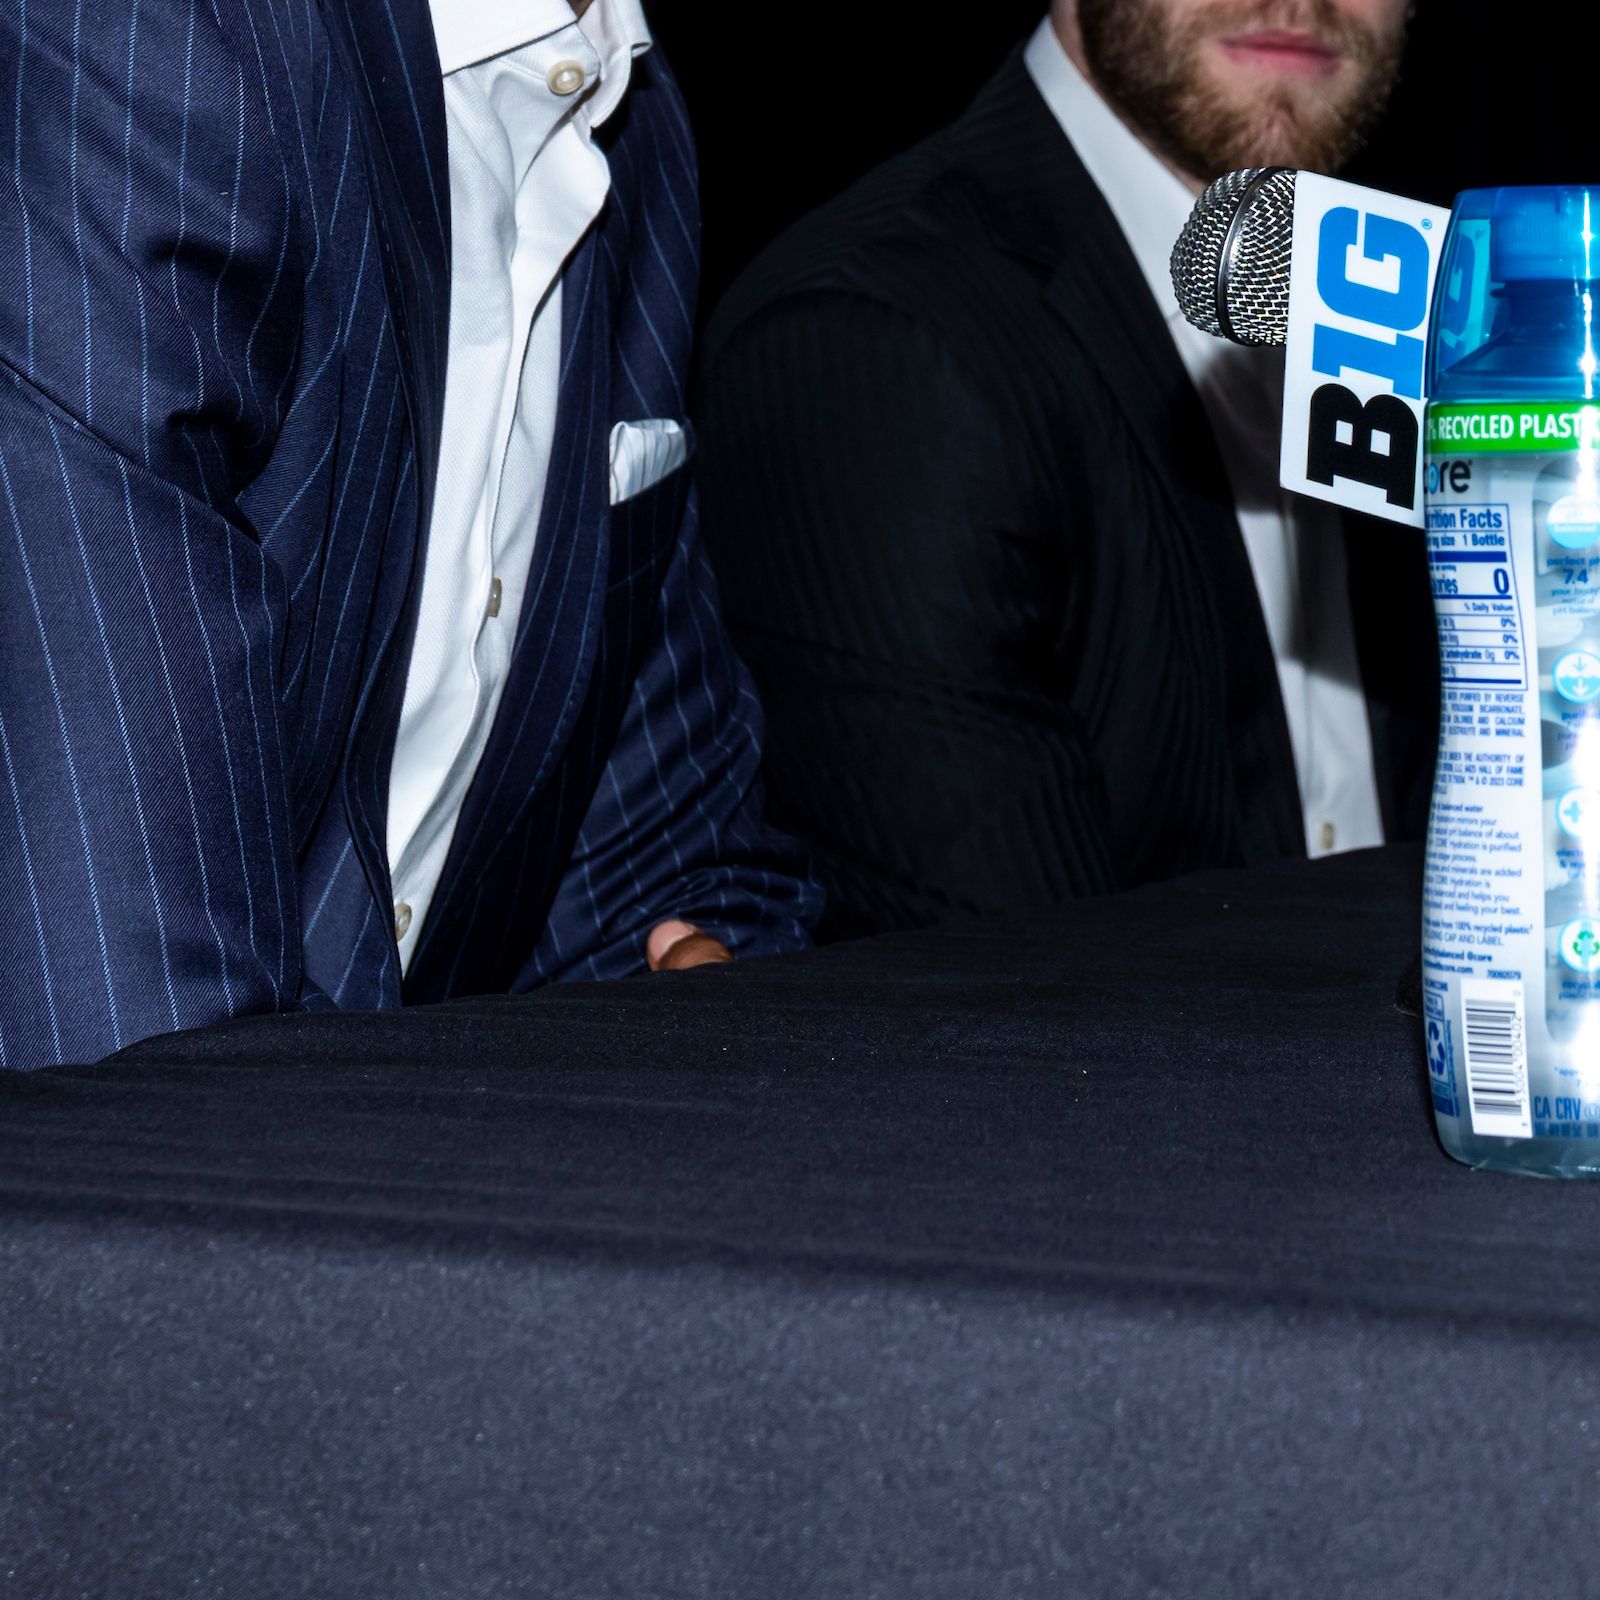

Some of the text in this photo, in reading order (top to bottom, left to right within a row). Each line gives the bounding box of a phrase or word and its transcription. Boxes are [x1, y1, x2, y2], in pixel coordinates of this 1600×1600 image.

[1438, 414, 1514, 440] RECYCLED
[1460, 509, 1502, 529] Facts
[1463, 534, 1468, 546] 1
[1472, 534, 1505, 547] Bottle
[1493, 568, 1510, 595] 0
[1563, 568, 1589, 585] 7.4
[1551, 588, 1572, 598] your
[1472, 602, 1513, 613] Daily Value
[1552, 606, 1566, 617] pH
[1495, 693, 1524, 703] REVERSE
[1495, 716, 1525, 726] CALCIUM
[1479, 727, 1525, 738] AND MINERAL
[1475, 753, 1511, 763] AUTHORITY
[1515, 754, 1525, 764] OF
[1478, 765, 1524, 776] HALL OF FAME
[1506, 777, 1524, 787] CORE
[1465, 805, 1484, 813] water
[1457, 816, 1497, 828] mirrors your
[1458, 828, 1519, 840] balance of about
[1481, 842, 1488, 850] is
[1489, 843, 1522, 853] purified
[1451, 866, 1478, 875] minerals
[1494, 868, 1522, 877] added
[1485, 879, 1491, 888] is
[1457, 891, 1470, 900] and
[1471, 892, 1492, 903] helps
[1494, 895, 1510, 904] you
[1456, 903, 1479, 914] feeling
[1480, 906, 1498, 916] your
[1501, 906, 1522, 915] best.
[1454, 921, 1471, 931] 100%
[1473, 923, 1503, 934] recycled
[1444, 932, 1504, 946] CAP AND LABEL.
[1466, 951, 1493, 962] @core
[1534, 1096, 1581, 1121] CA CRV
